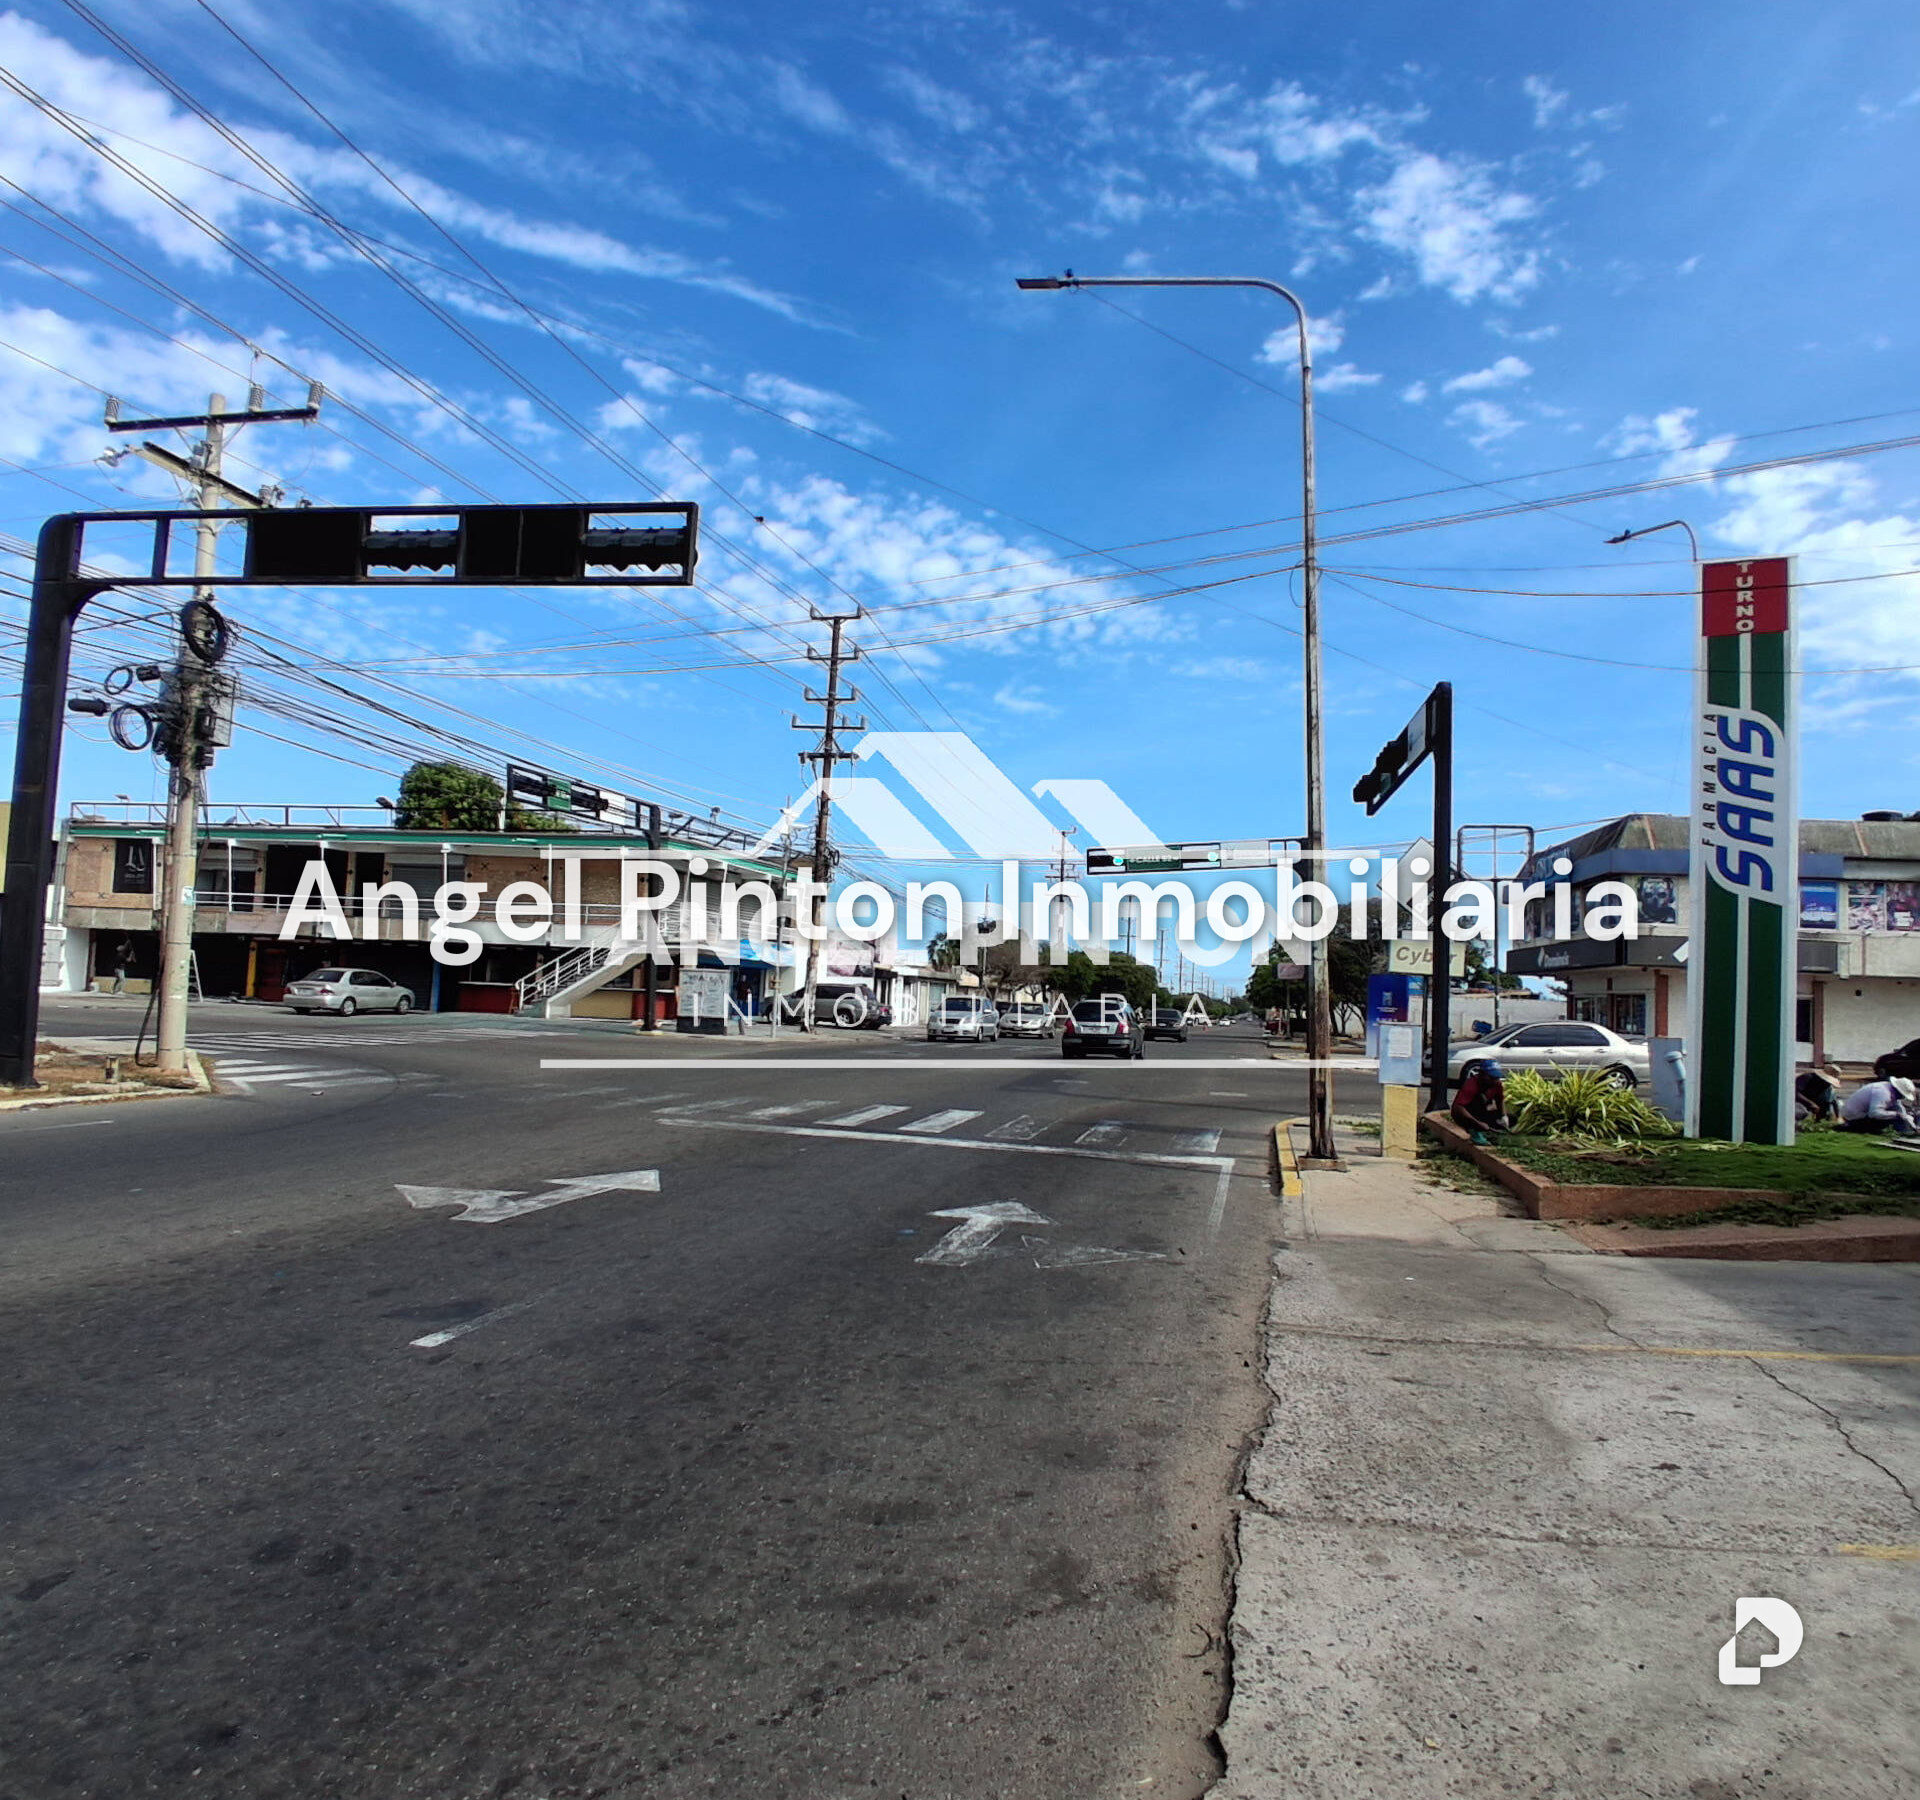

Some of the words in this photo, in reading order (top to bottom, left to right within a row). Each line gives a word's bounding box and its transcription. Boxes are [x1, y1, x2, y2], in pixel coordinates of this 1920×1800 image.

[1736, 562, 1754, 632] TURNO
[1702, 714, 1718, 847] FARMACIA
[1716, 715, 1774, 892] SAAS
[1396, 946, 1456, 965] Cybr
